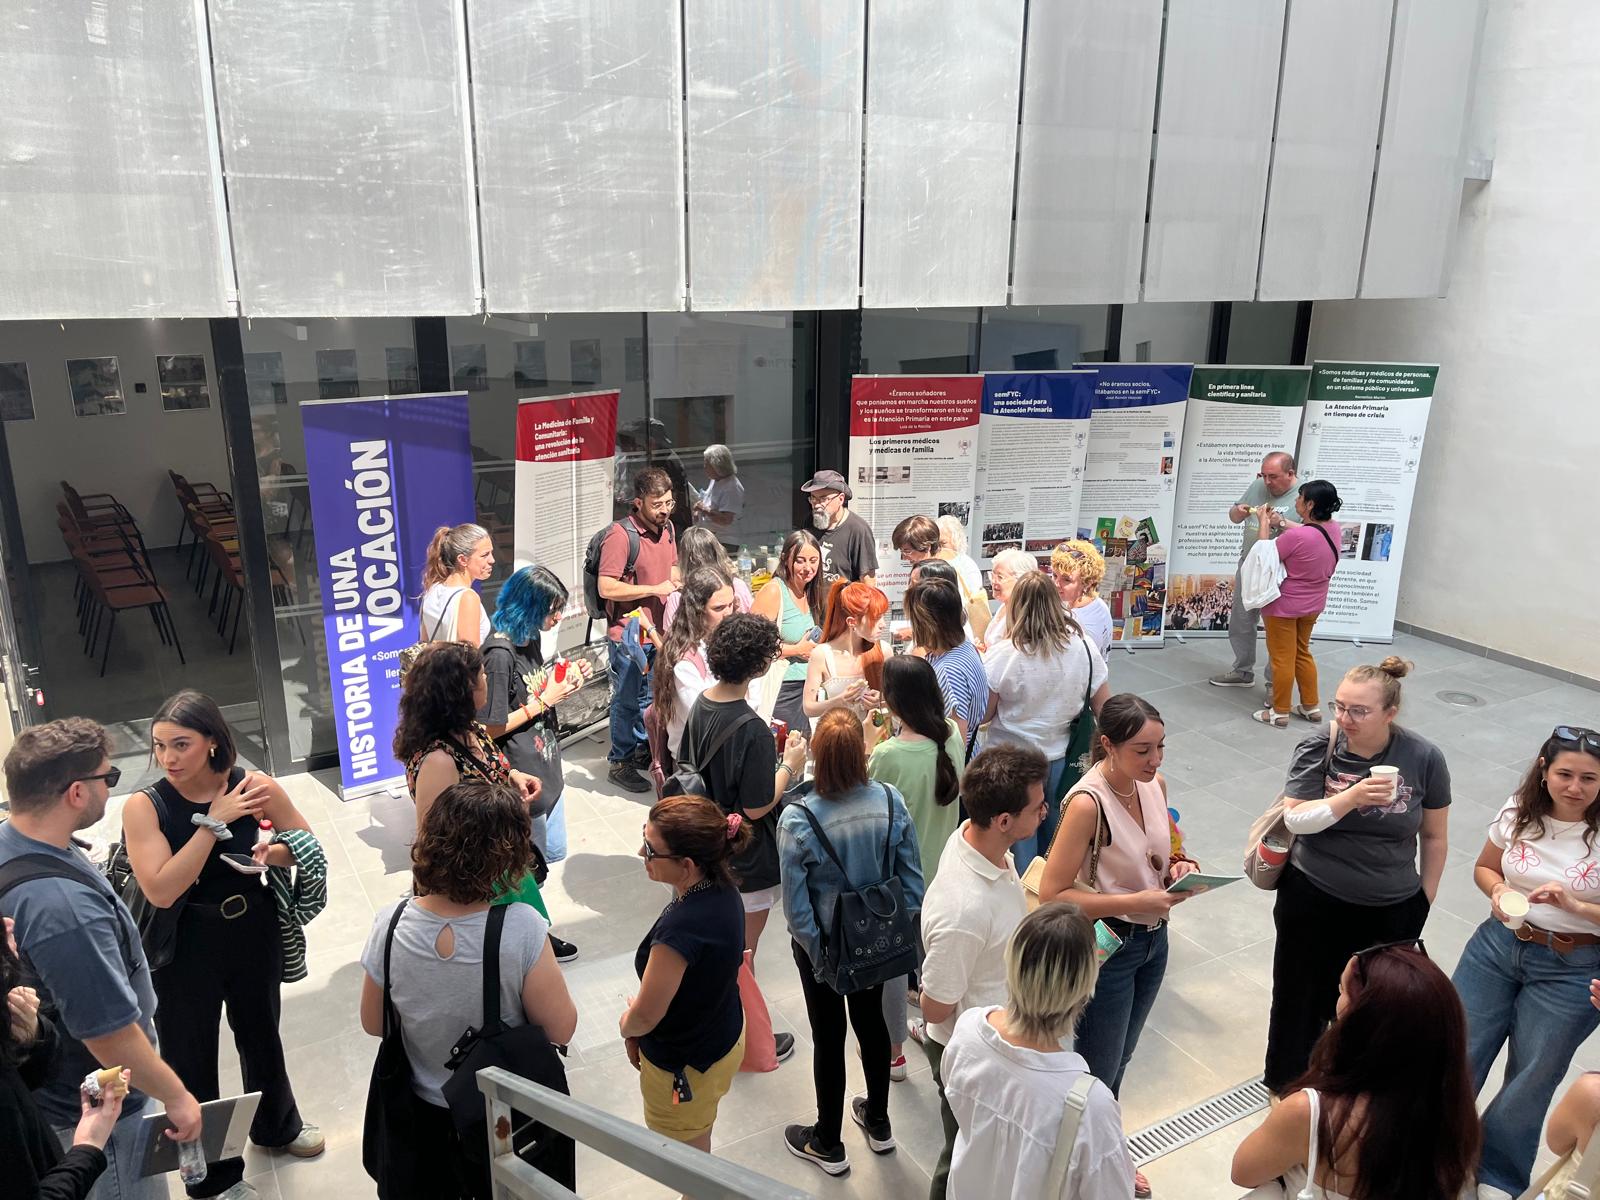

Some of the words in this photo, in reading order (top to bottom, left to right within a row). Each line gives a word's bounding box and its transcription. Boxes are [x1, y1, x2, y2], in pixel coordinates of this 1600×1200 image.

[542, 420, 564, 429] Medicina
[572, 416, 590, 425] Familia
[535, 429, 567, 440] Comunitaria:
[535, 443, 545, 451] una
[545, 438, 570, 449] revolución
[571, 437, 578, 445] de
[535, 451, 557, 461] atención
[558, 447, 580, 457] sanitaria
[345, 440, 404, 642] VOCACIÓN
[329, 547, 361, 610] UNA
[336, 612, 365, 652] DE
[372, 649, 403, 661] «Som
[340, 654, 378, 779] HISTORIA
